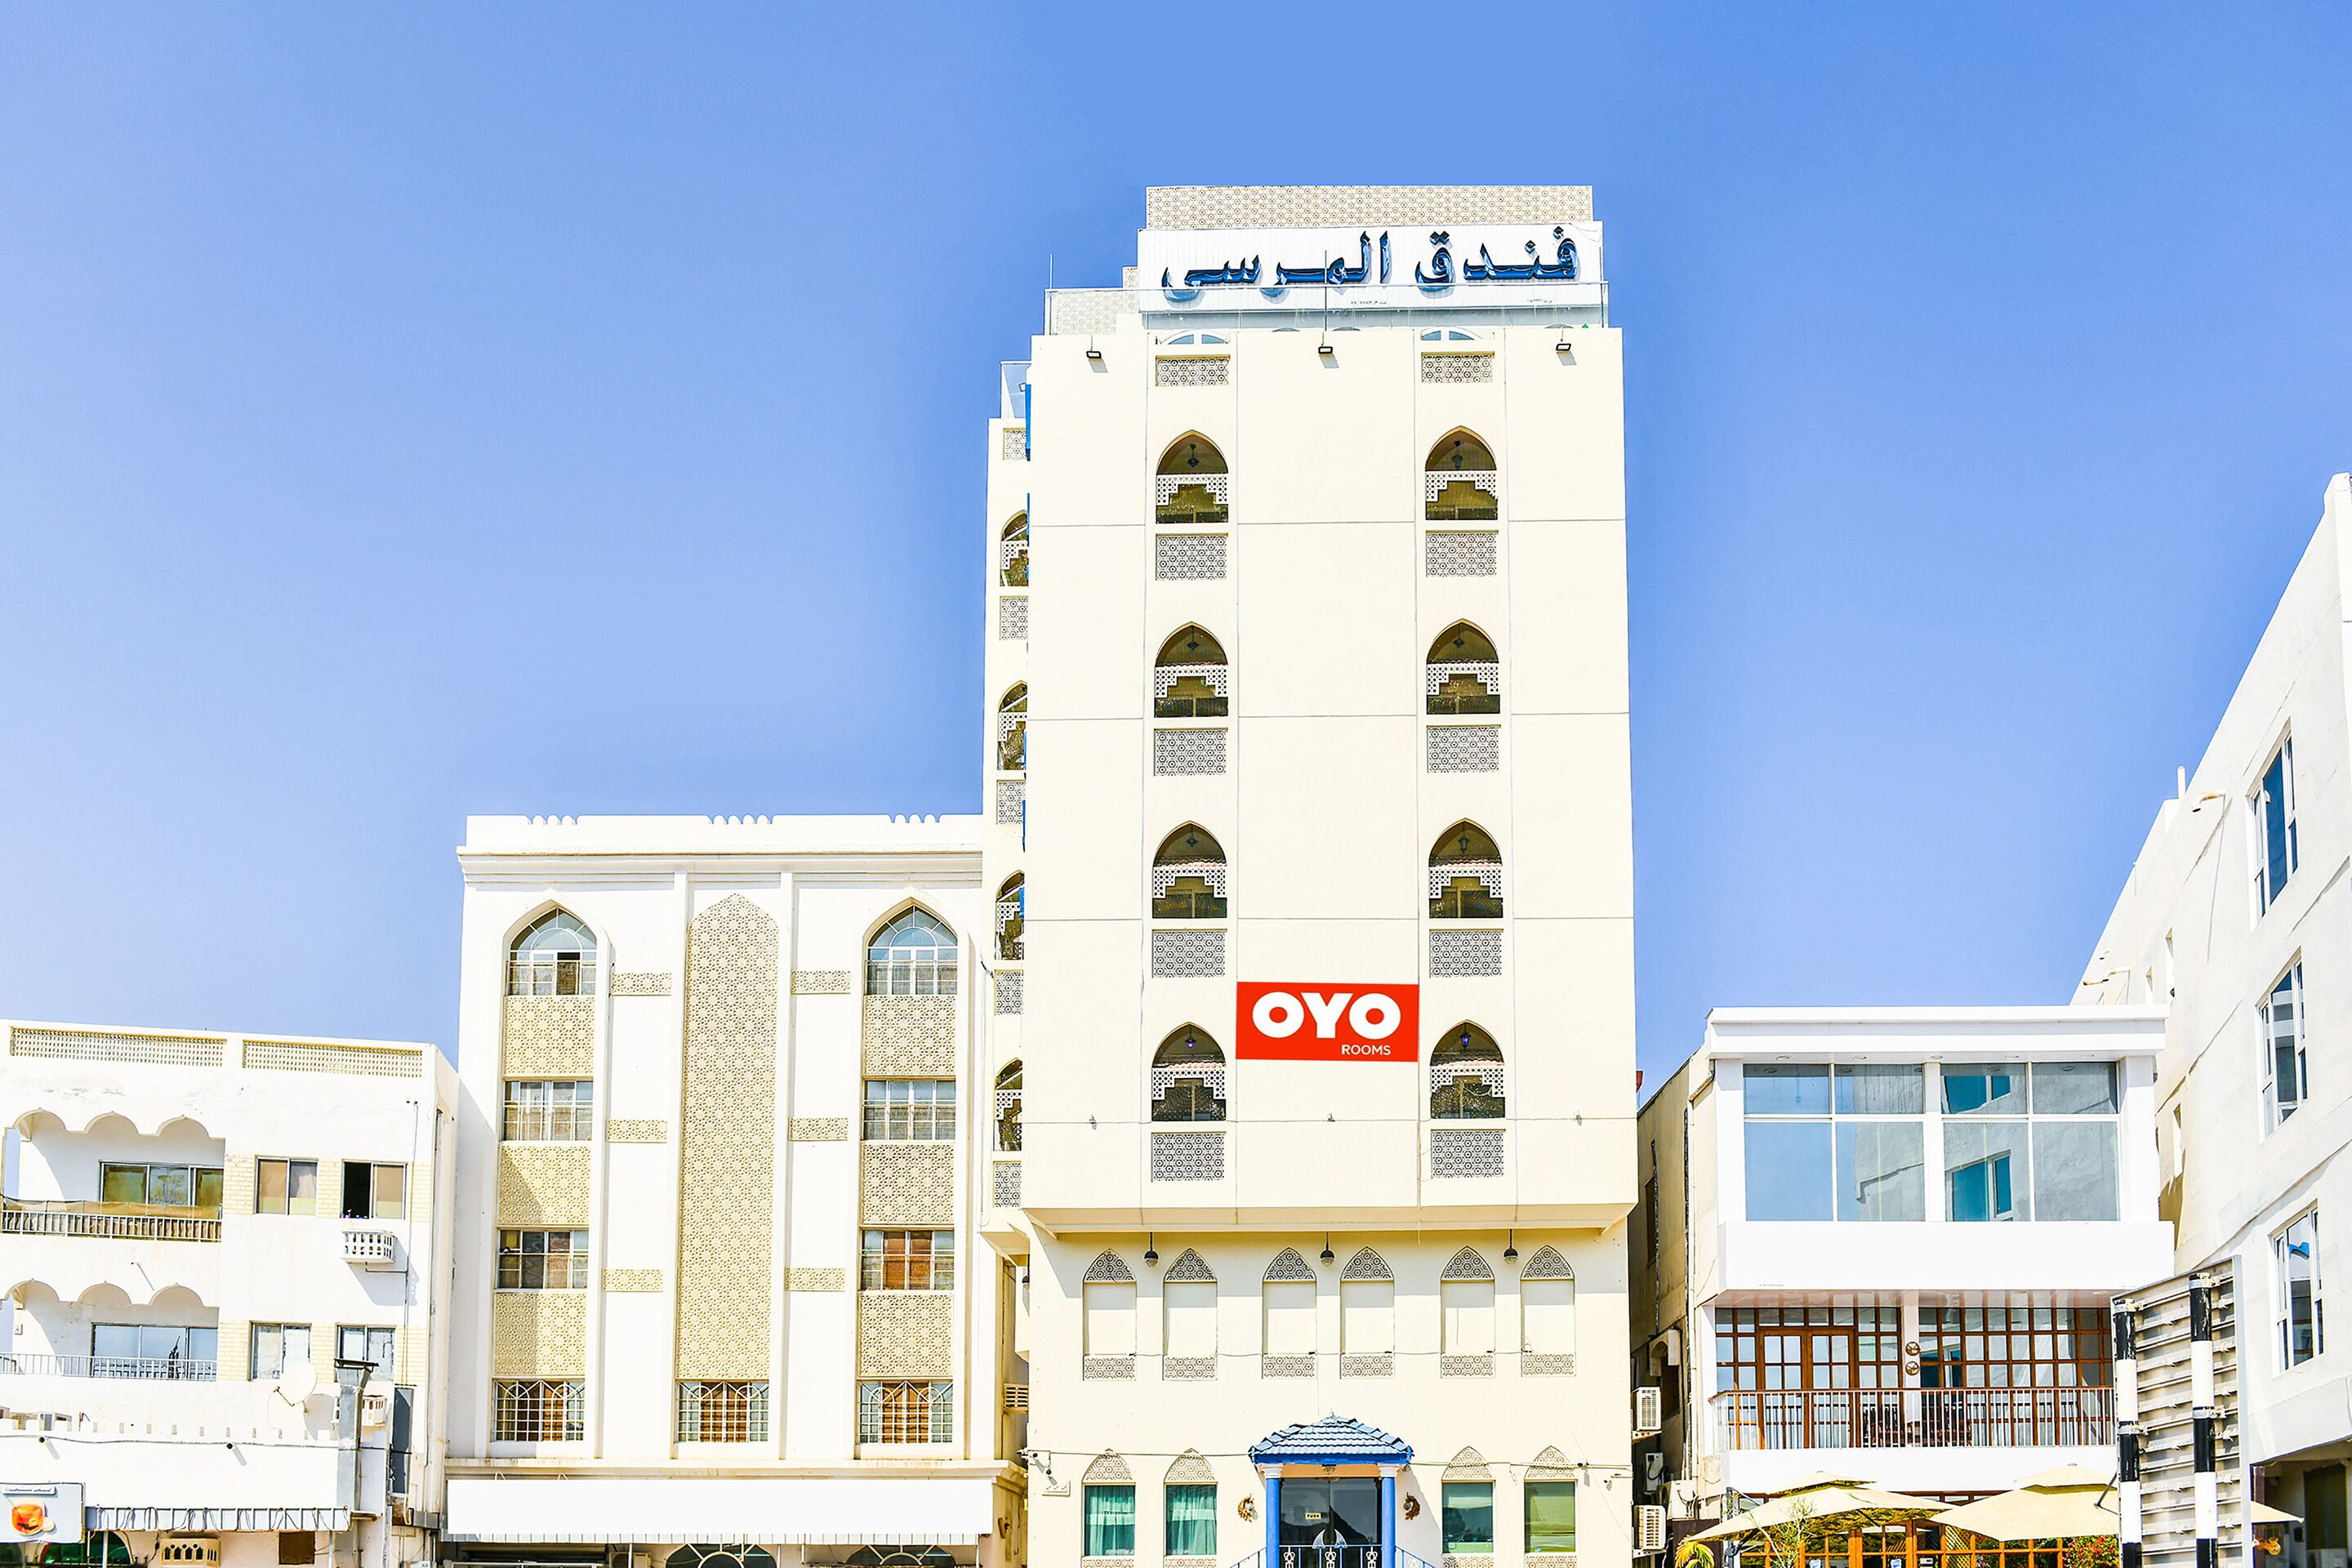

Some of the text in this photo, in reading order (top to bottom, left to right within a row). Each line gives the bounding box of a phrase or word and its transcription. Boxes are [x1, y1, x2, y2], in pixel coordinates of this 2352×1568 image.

[1414, 225, 1578, 292] فندق
[1252, 991, 1401, 1040] OYO
[1341, 1045, 1392, 1056] ROOMS
